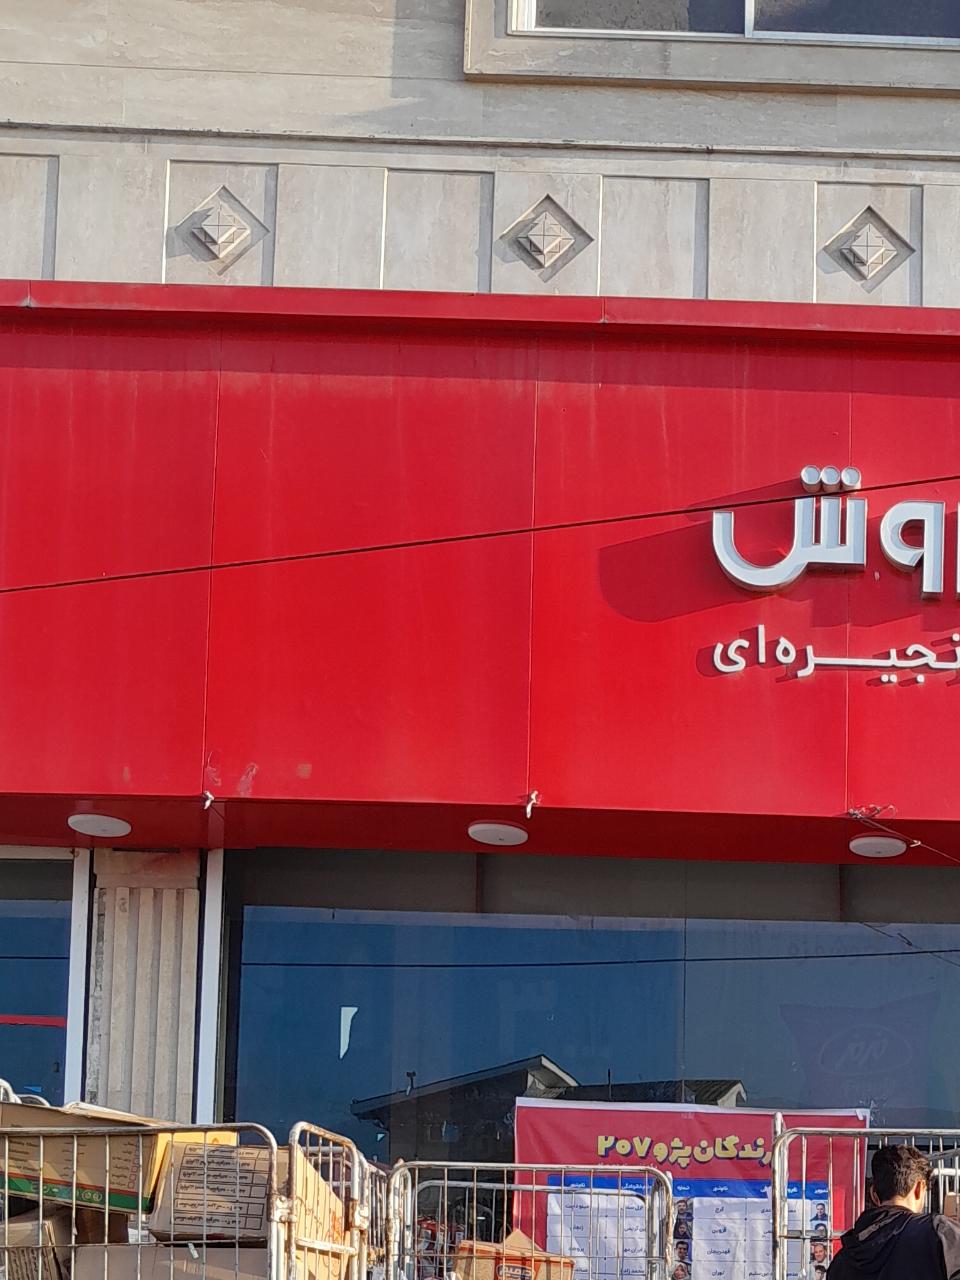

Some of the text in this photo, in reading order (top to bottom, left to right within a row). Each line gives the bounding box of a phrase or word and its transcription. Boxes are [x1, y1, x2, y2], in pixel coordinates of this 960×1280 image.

[597, 1134, 772, 1168] رندگان پژو ۲۰۷
